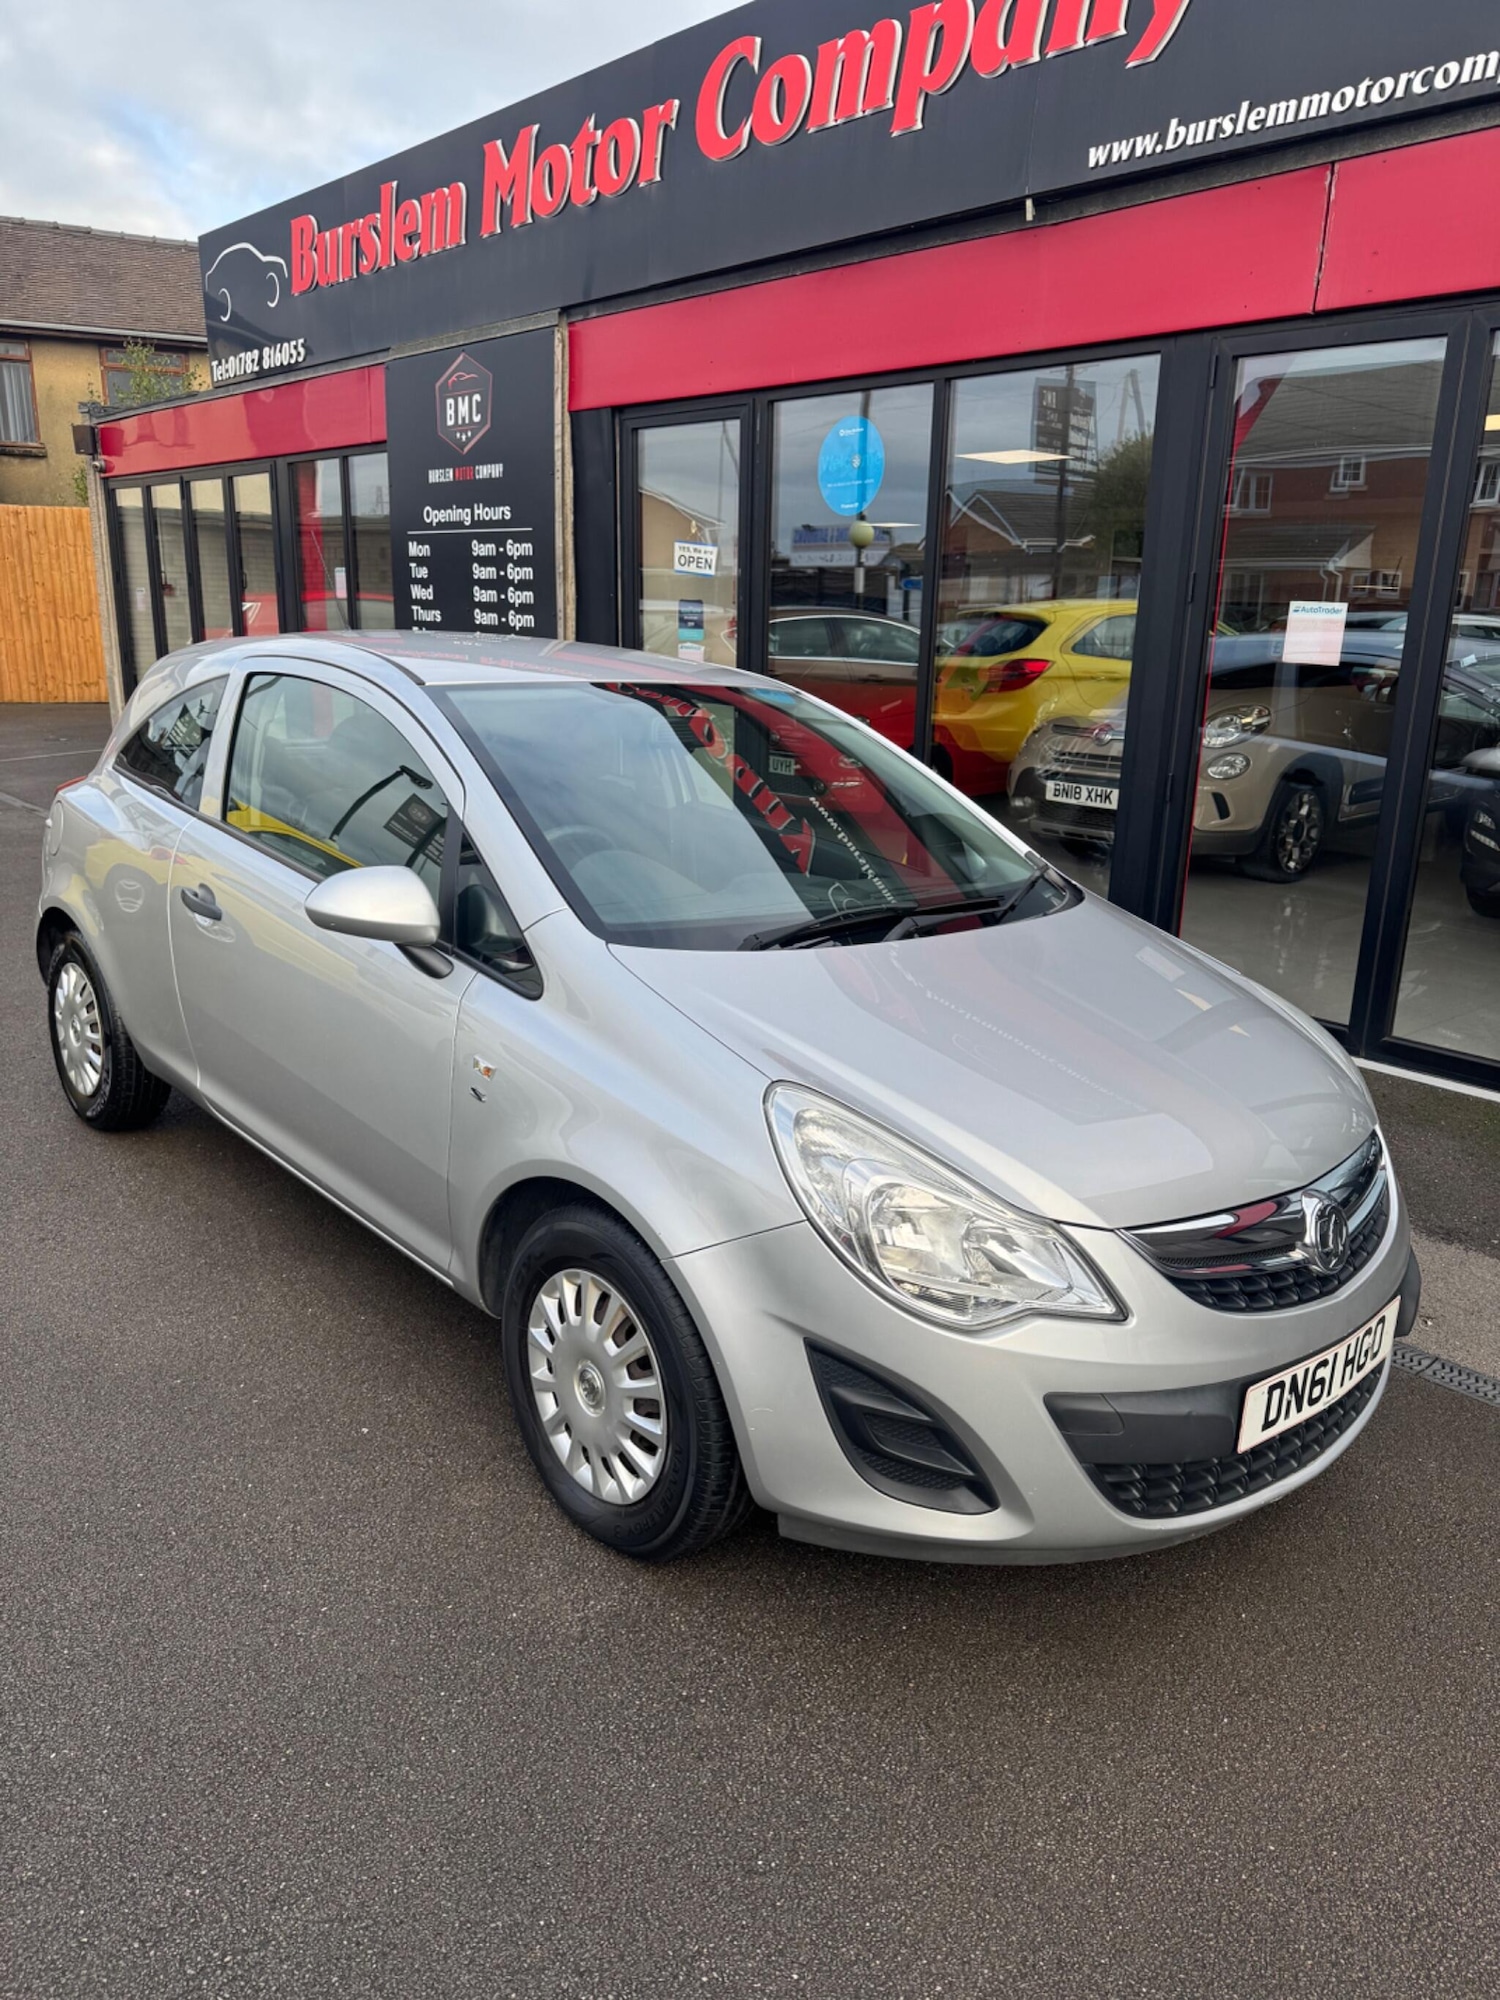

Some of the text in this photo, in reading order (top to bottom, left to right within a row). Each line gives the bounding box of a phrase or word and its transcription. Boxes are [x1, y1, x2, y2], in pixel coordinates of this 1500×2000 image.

[1088, 50, 1500, 167] www.burslemmotorcom
[290, 179, 466, 296] Burslem
[480, 99, 681, 238] Motor
[262, 338, 305, 370] 816055
[446, 393, 482, 427] BMC
[423, 505, 511, 526] Opening Hours
[408, 541, 431, 557] Mon
[471, 540, 497, 556] 9am
[506, 539, 533, 560] 6pm
[409, 563, 429, 579] Tue
[472, 562, 497, 580] 9am
[506, 562, 534, 584] 6pm
[678, 554, 712, 570] OPEN
[410, 584, 434, 600] Wed
[473, 585, 498, 602] 9am
[507, 586, 535, 607] 6pm
[411, 605, 442, 622] Thurs
[473, 608, 499, 625] 9am
[508, 609, 535, 631] 6pm
[1300, 605, 1343, 615] AutoTrader
[1053, 782, 1113, 805] BN18 XHK
[1261, 1352, 1338, 1432] DN61
